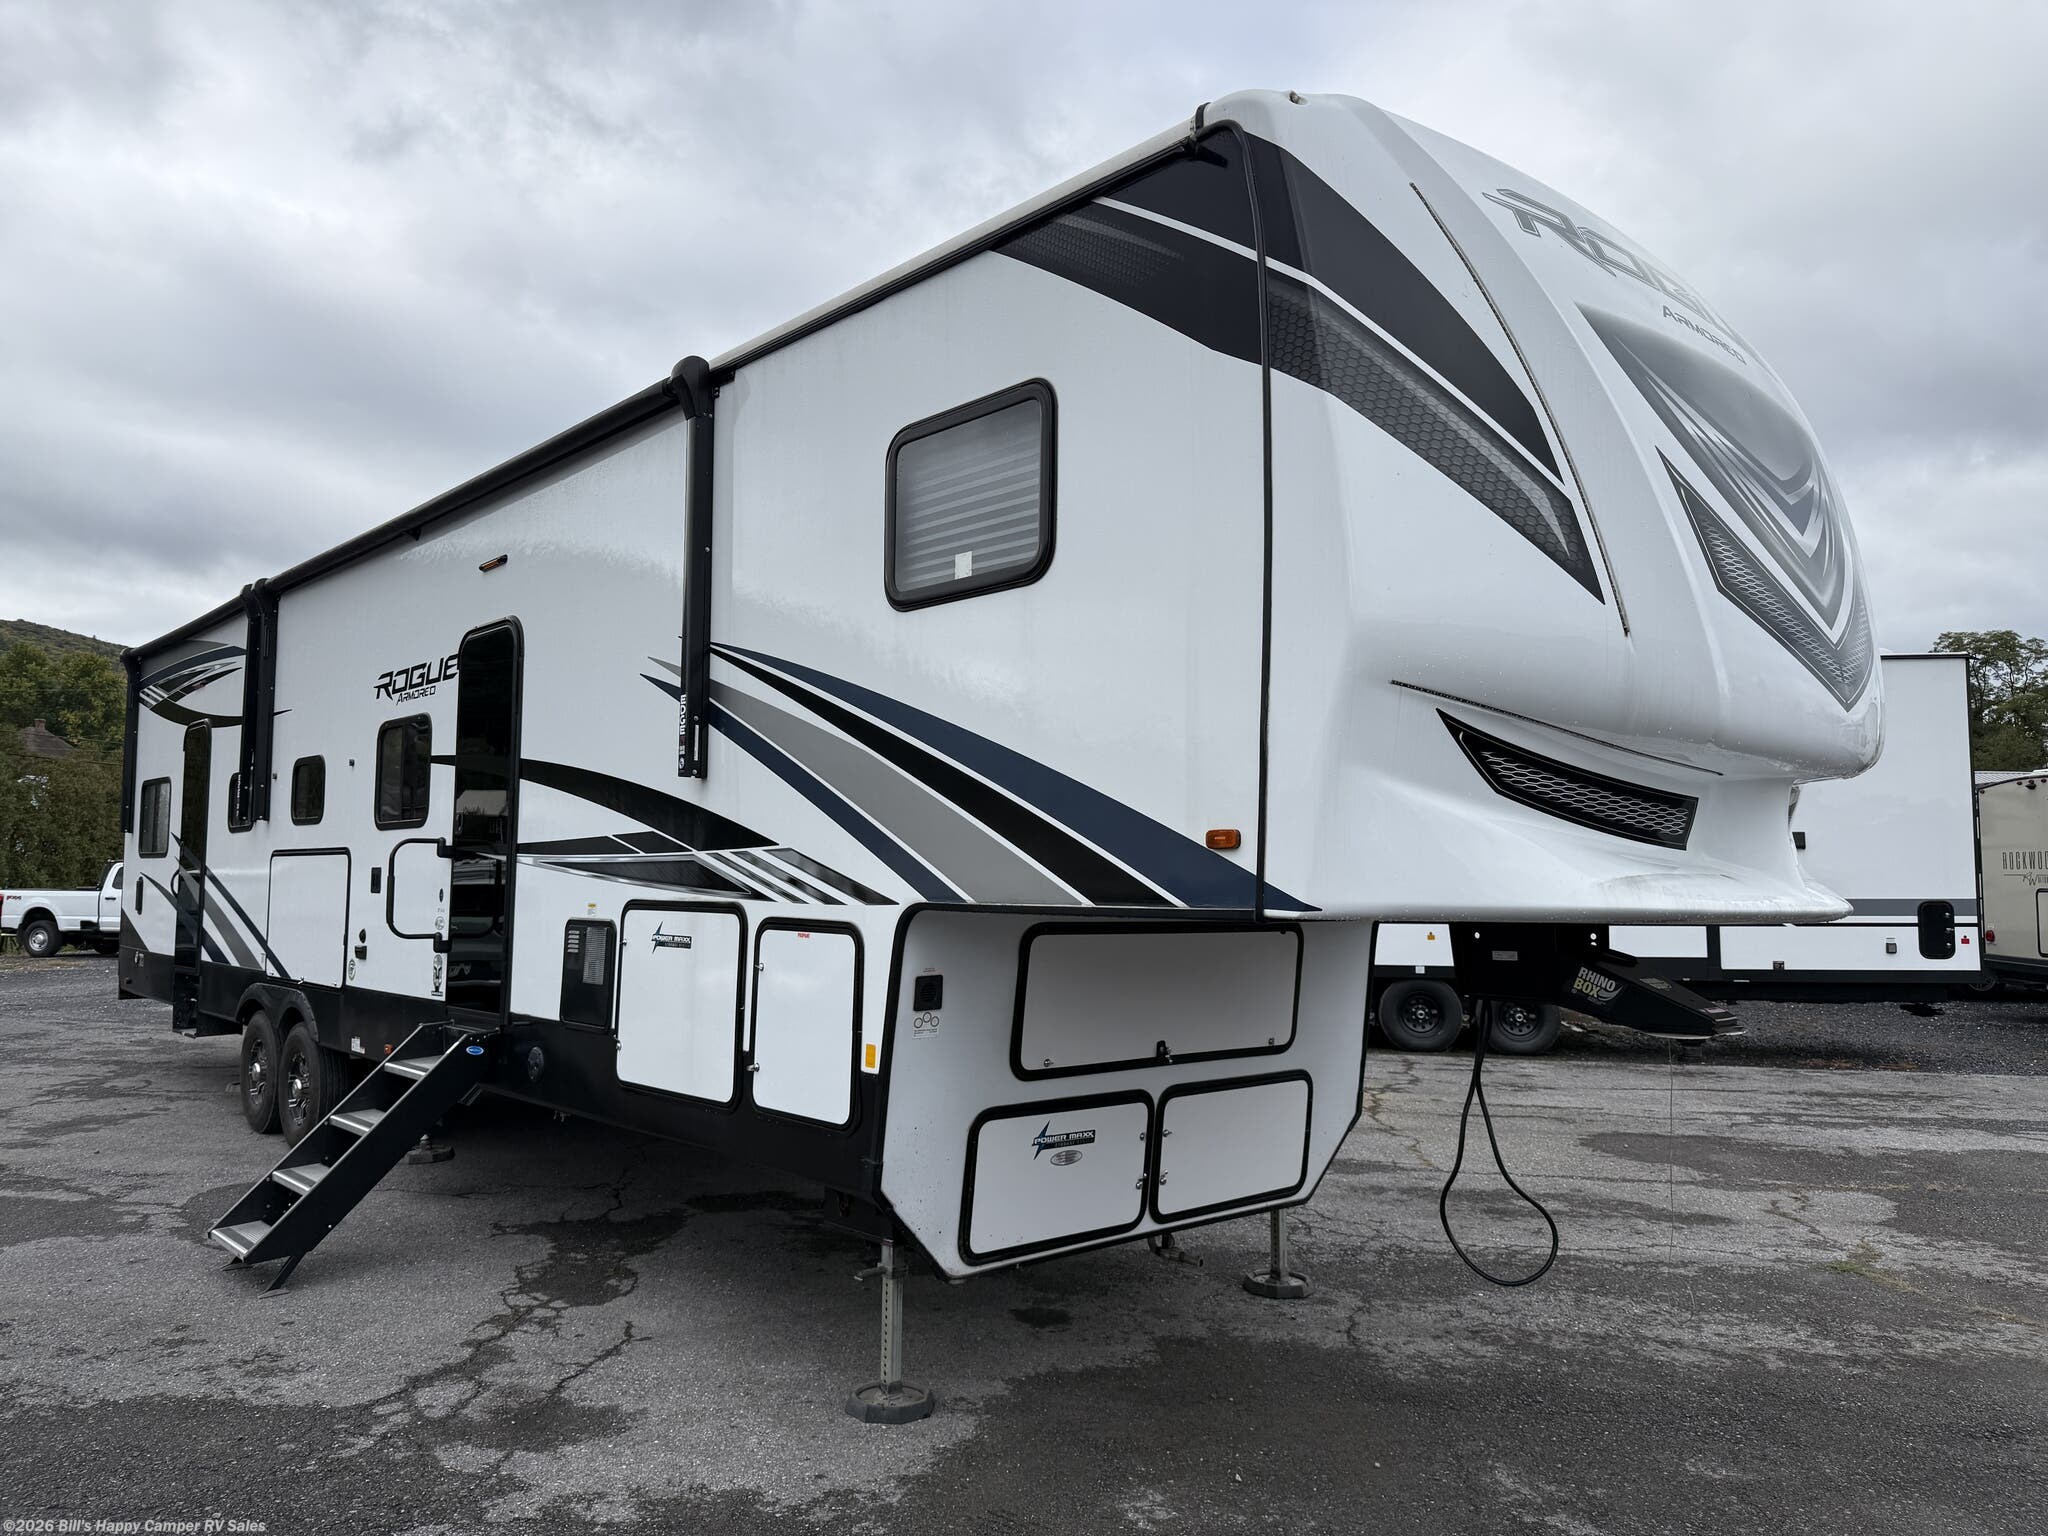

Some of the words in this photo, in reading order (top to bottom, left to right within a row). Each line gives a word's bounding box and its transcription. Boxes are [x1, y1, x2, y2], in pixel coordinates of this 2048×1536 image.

[1662, 305, 1747, 366] ARMORED
[373, 653, 459, 701] ROGUE
[396, 685, 436, 706] ARMORED
[1573, 977, 1600, 998] BOX
[1578, 966, 1616, 991] RHINO
[1034, 1133, 1067, 1145] POWER
